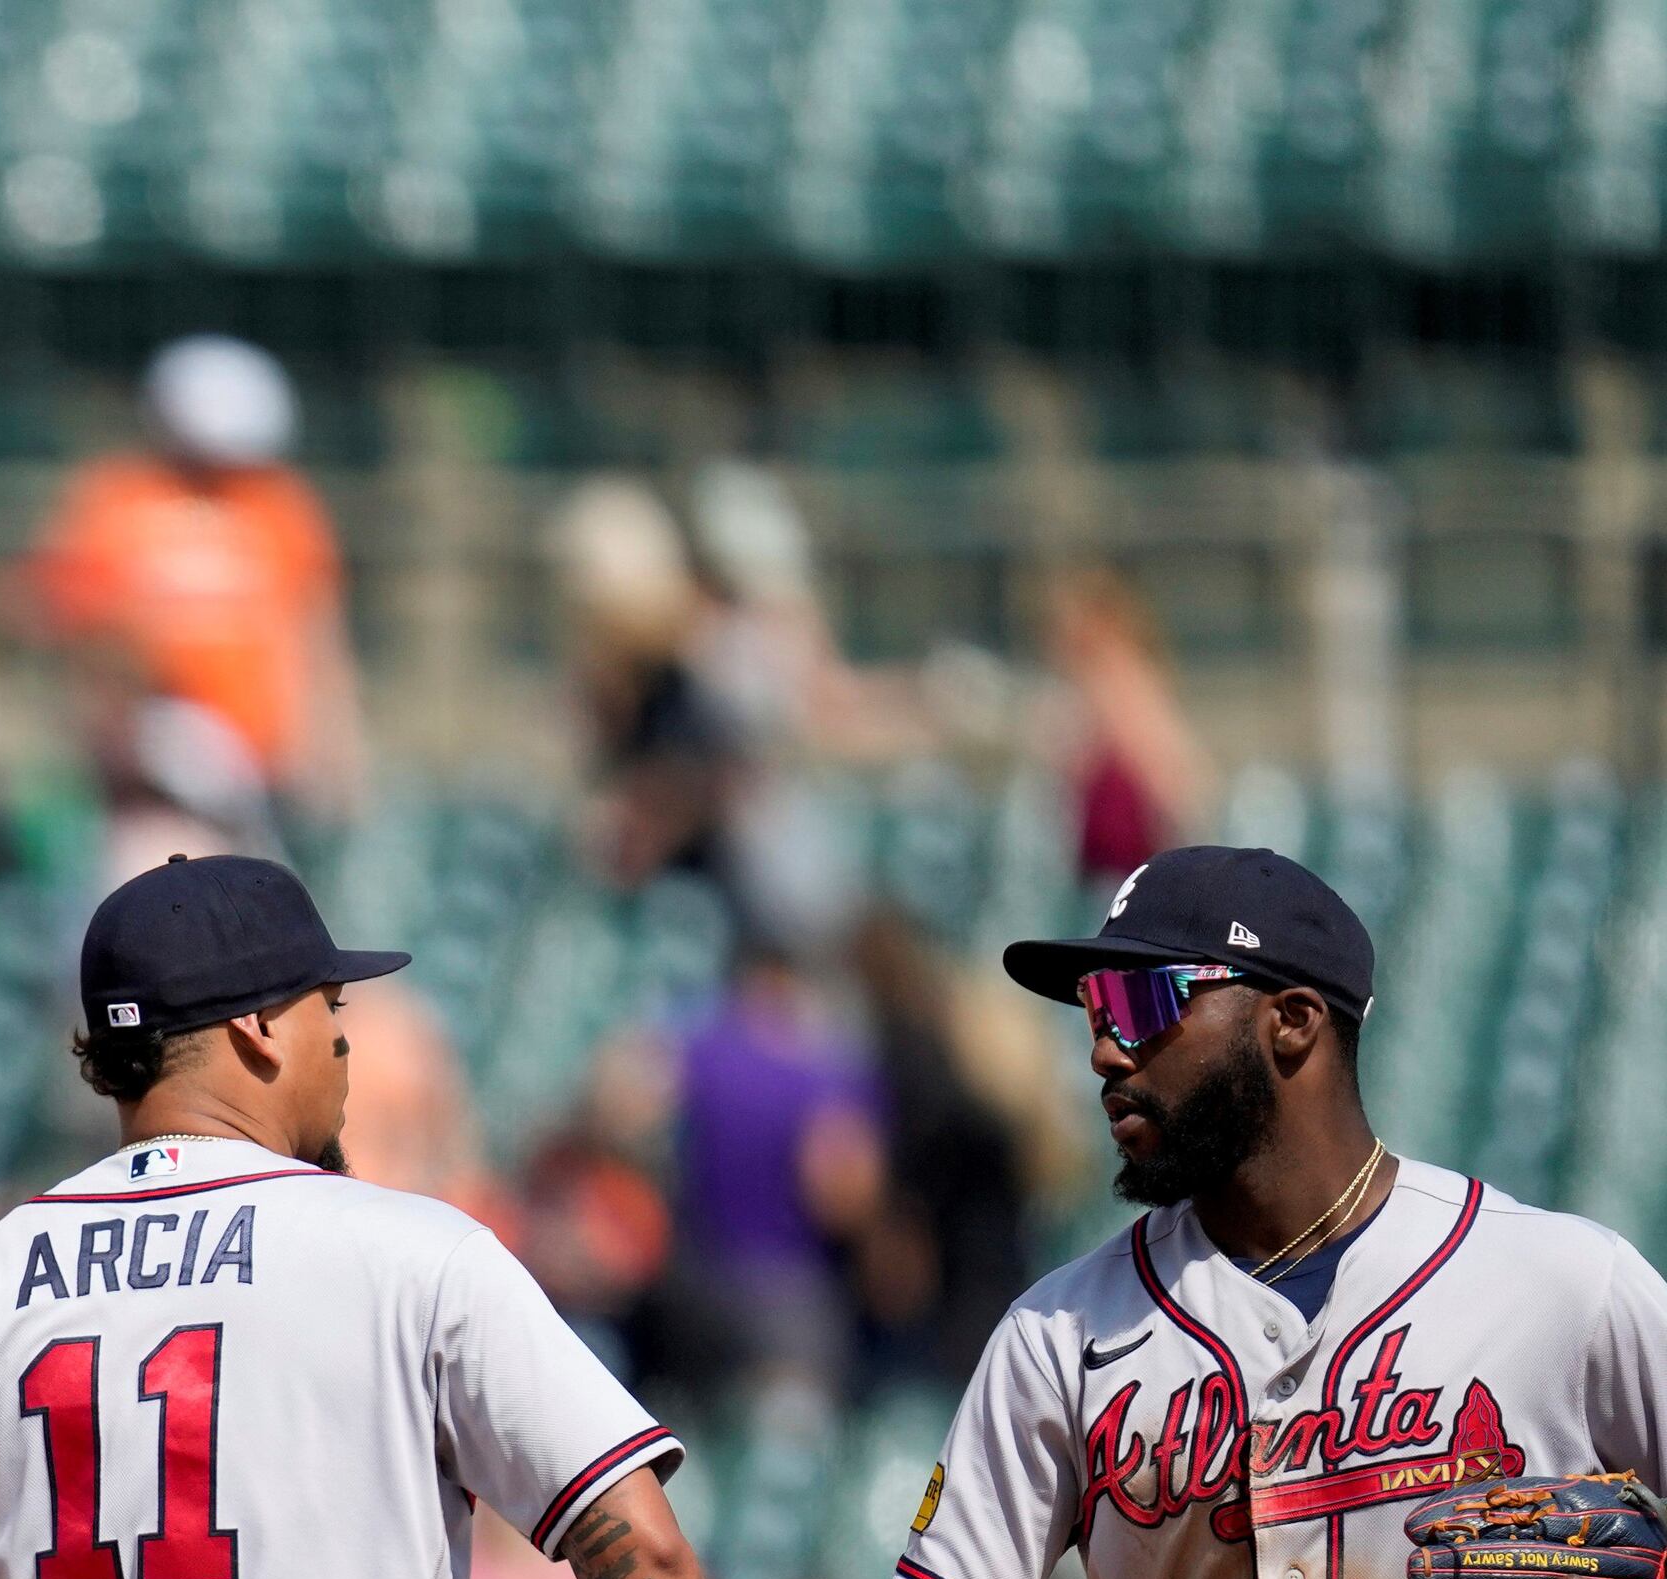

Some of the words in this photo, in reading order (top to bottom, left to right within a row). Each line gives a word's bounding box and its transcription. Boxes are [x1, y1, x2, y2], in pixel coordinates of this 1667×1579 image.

[16, 1205, 256, 1309] ARCIA
[1082, 1323, 1443, 1543] Atlanta
[1463, 1551, 1515, 1567] Sawry
[1519, 1552, 1548, 1567] Not
[1551, 1552, 1600, 1572] Sawry
